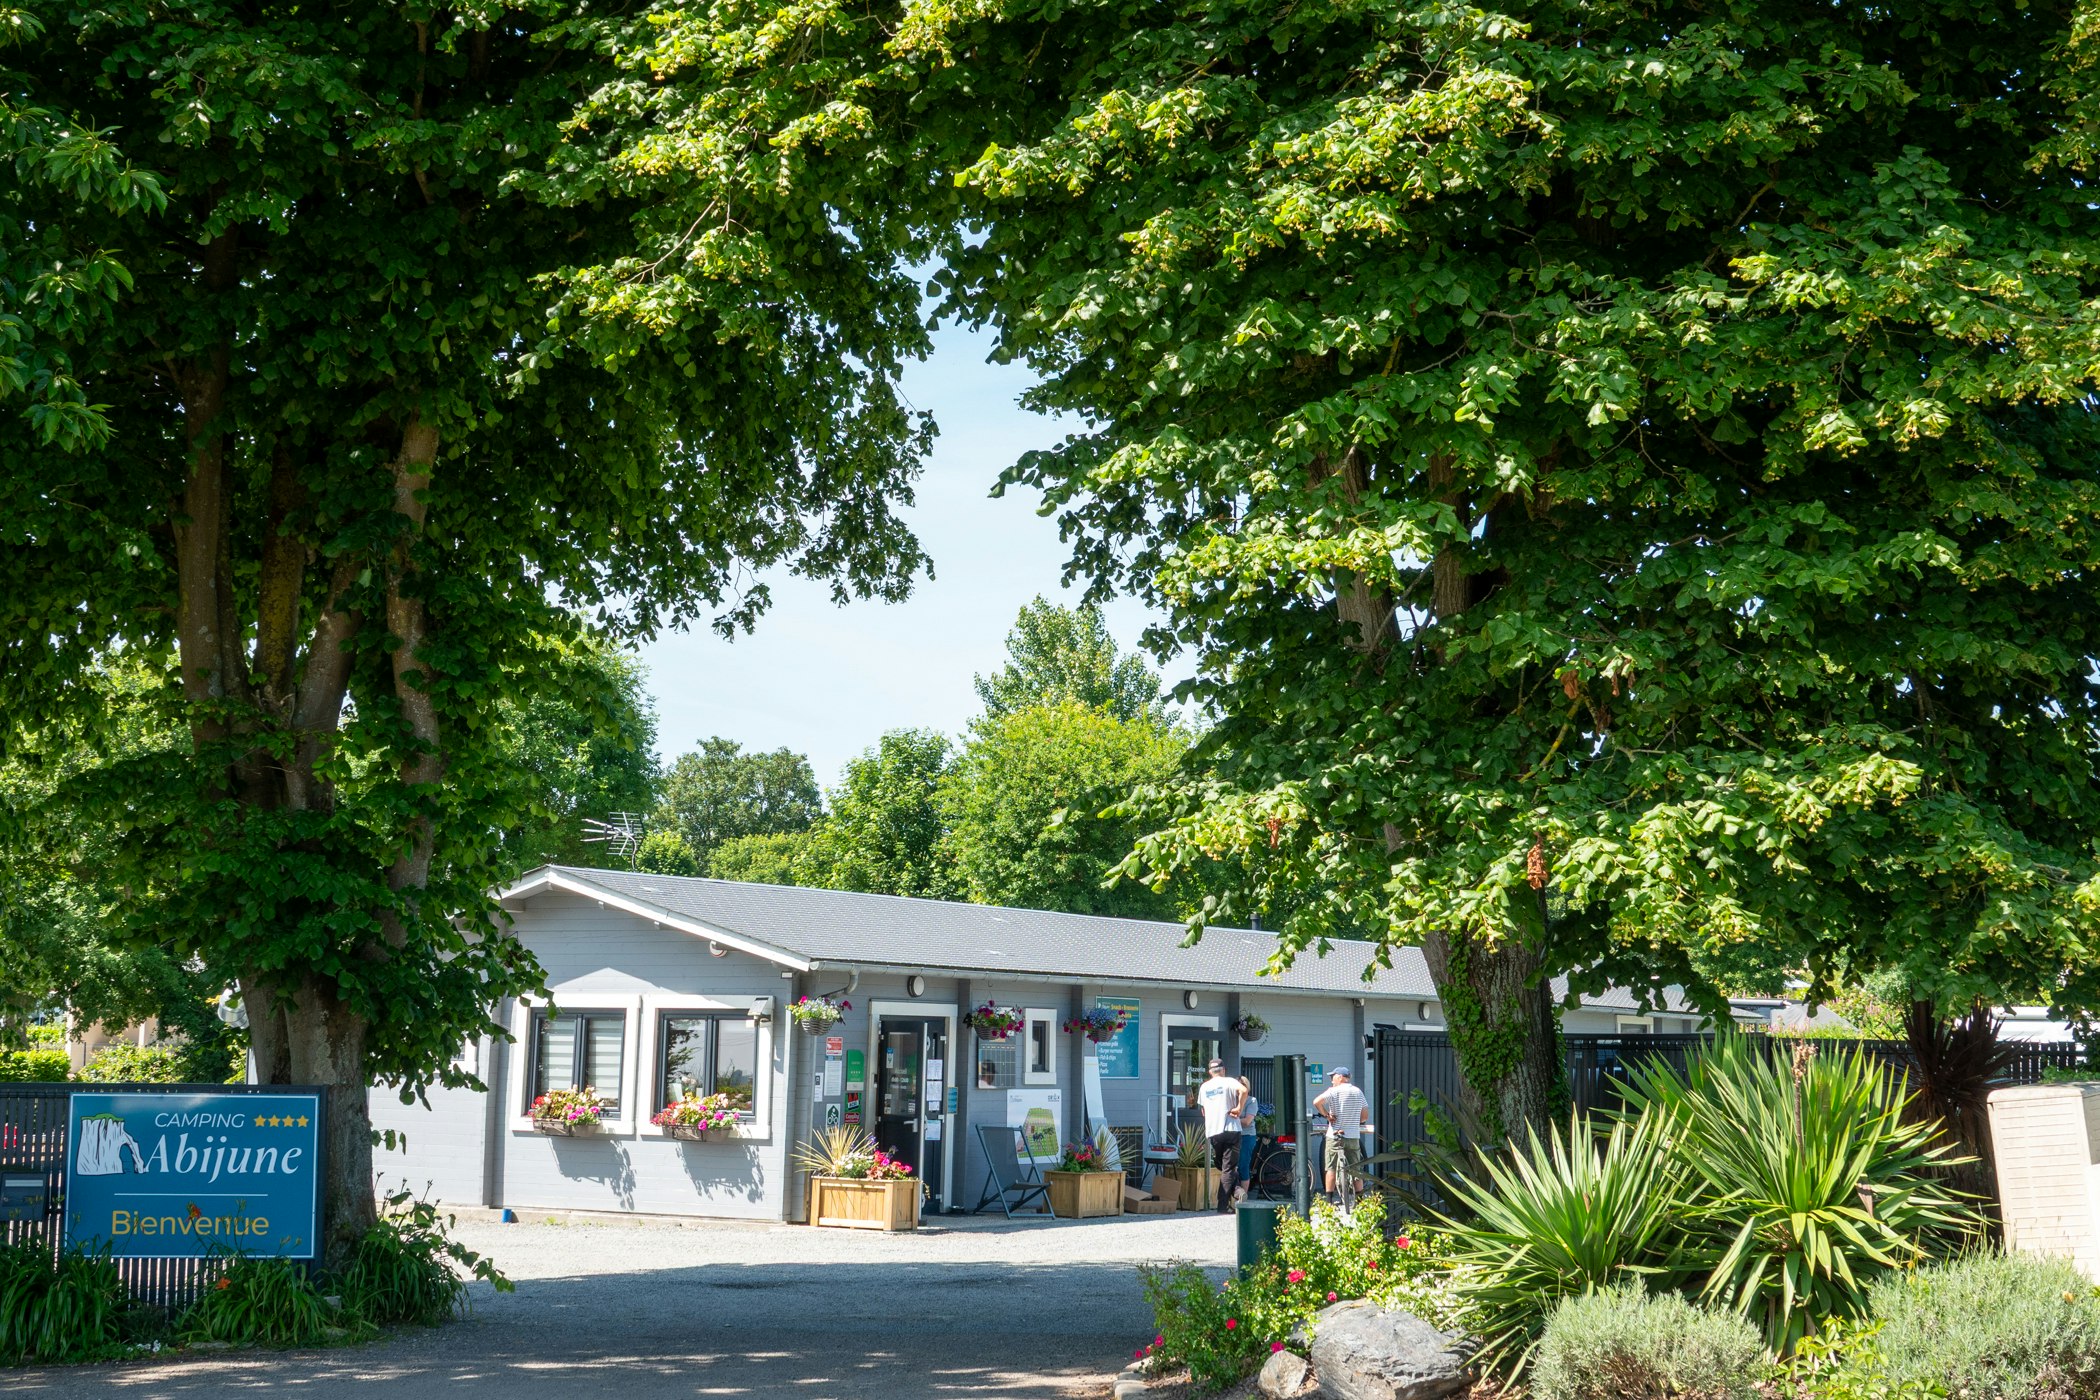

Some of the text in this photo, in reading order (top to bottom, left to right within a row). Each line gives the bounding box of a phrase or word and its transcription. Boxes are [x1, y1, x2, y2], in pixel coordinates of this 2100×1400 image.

[154, 1112, 246, 1128] CAMPING
[145, 1132, 303, 1184] Abijune
[111, 1210, 270, 1236] Bienvenue
